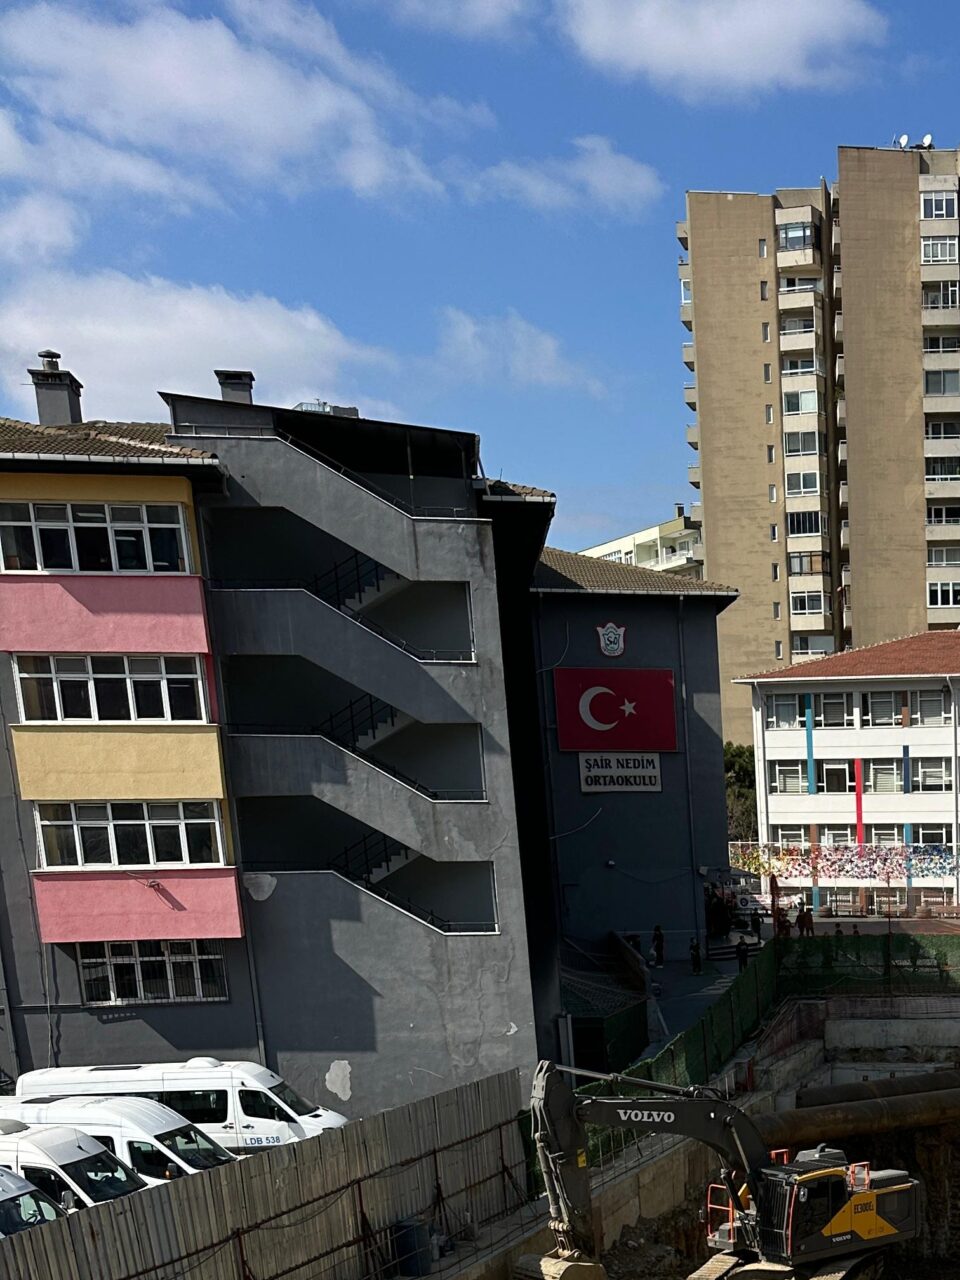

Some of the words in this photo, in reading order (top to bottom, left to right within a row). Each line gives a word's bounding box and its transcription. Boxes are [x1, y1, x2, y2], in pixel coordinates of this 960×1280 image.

[585, 755, 612, 772] ŞAİR
[616, 755, 656, 770] NEDİM
[585, 775, 657, 786] ORTAOKULU
[616, 1109, 675, 1123] VOLVO
[244, 1137, 263, 1146] LDB
[265, 1135, 281, 1144] 538
